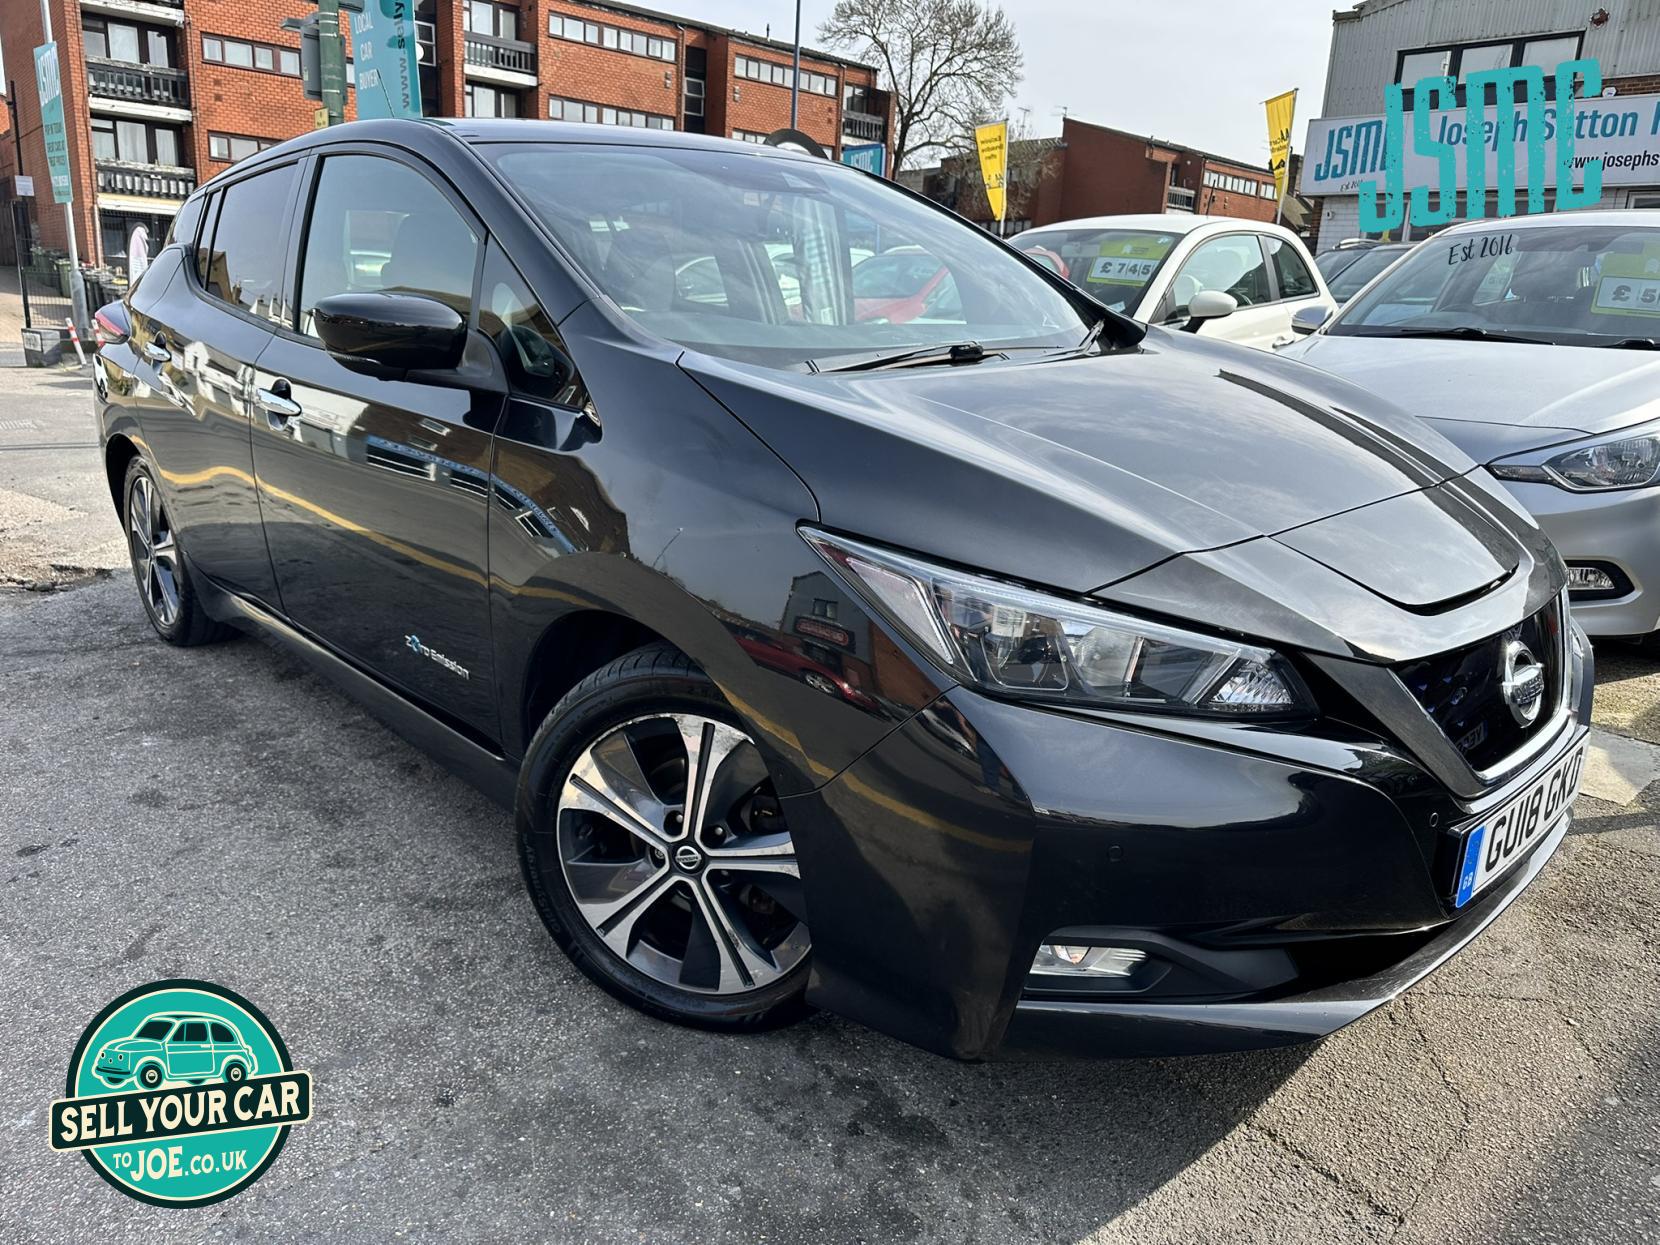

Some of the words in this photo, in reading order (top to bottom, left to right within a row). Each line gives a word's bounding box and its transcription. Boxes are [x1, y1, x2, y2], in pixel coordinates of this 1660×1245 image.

[354, 11, 374, 34] LOCAL
[361, 41, 373, 62] CAR
[360, 68, 379, 90] BUYER
[1439, 111, 1528, 152] Joeh
[1544, 109, 1639, 140] Stton
[1314, 120, 1386, 181] JSM
[1485, 784, 1543, 872] GU18
[1462, 872, 1474, 890] GB
